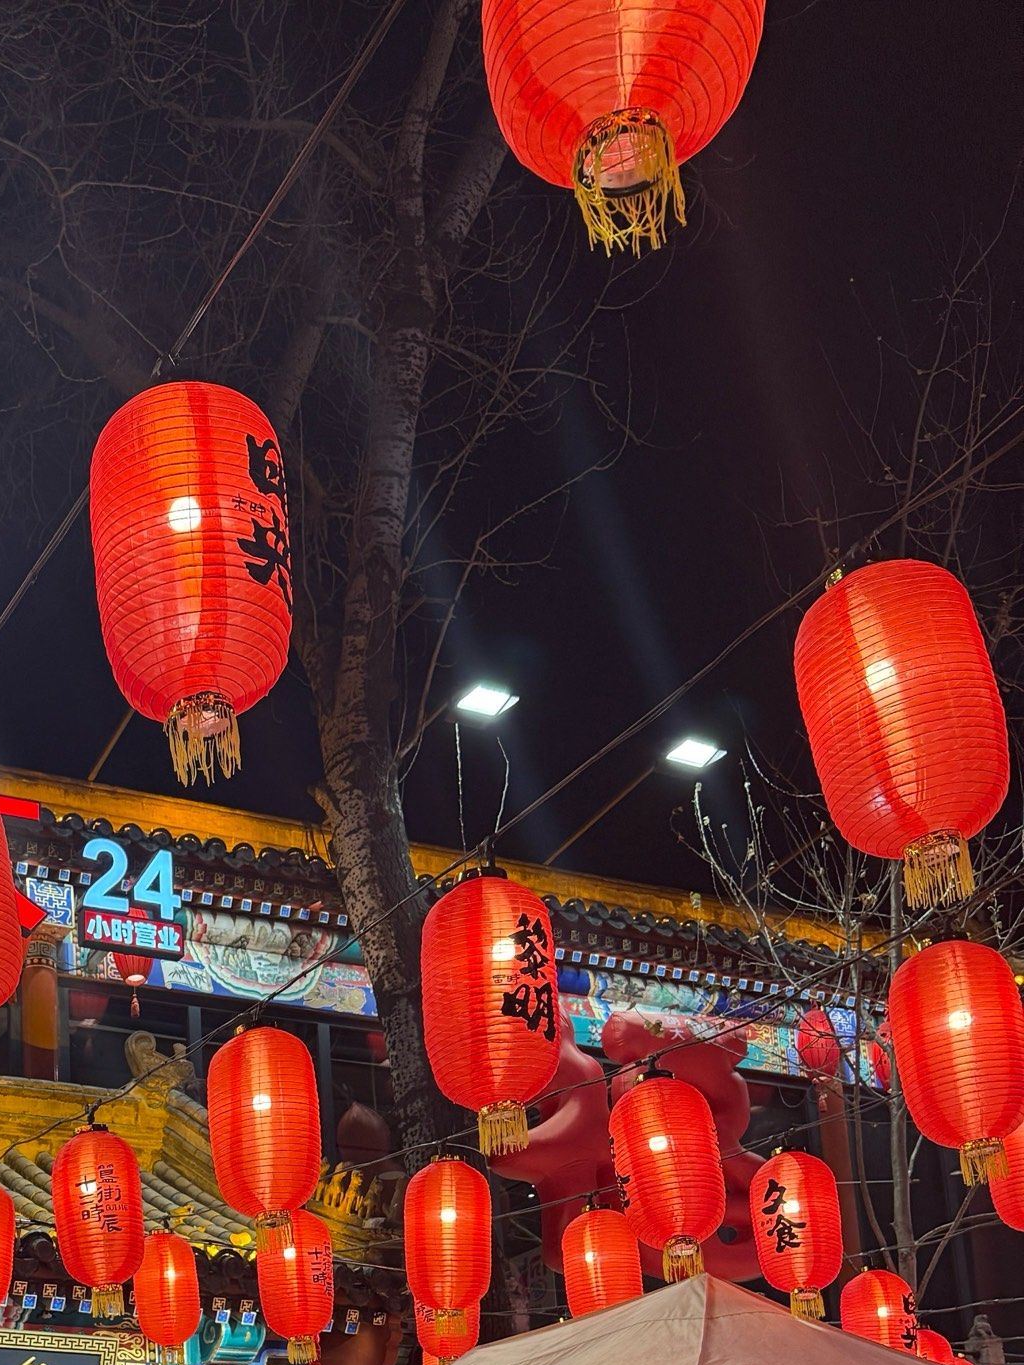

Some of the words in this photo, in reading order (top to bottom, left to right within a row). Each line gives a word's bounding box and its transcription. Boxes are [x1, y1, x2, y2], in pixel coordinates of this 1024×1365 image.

[83, 838, 181, 920] 24
[87, 915, 181, 952] 小时营业
[501, 913, 557, 1042] 黎明
[762, 1179, 807, 1253] 夕食
